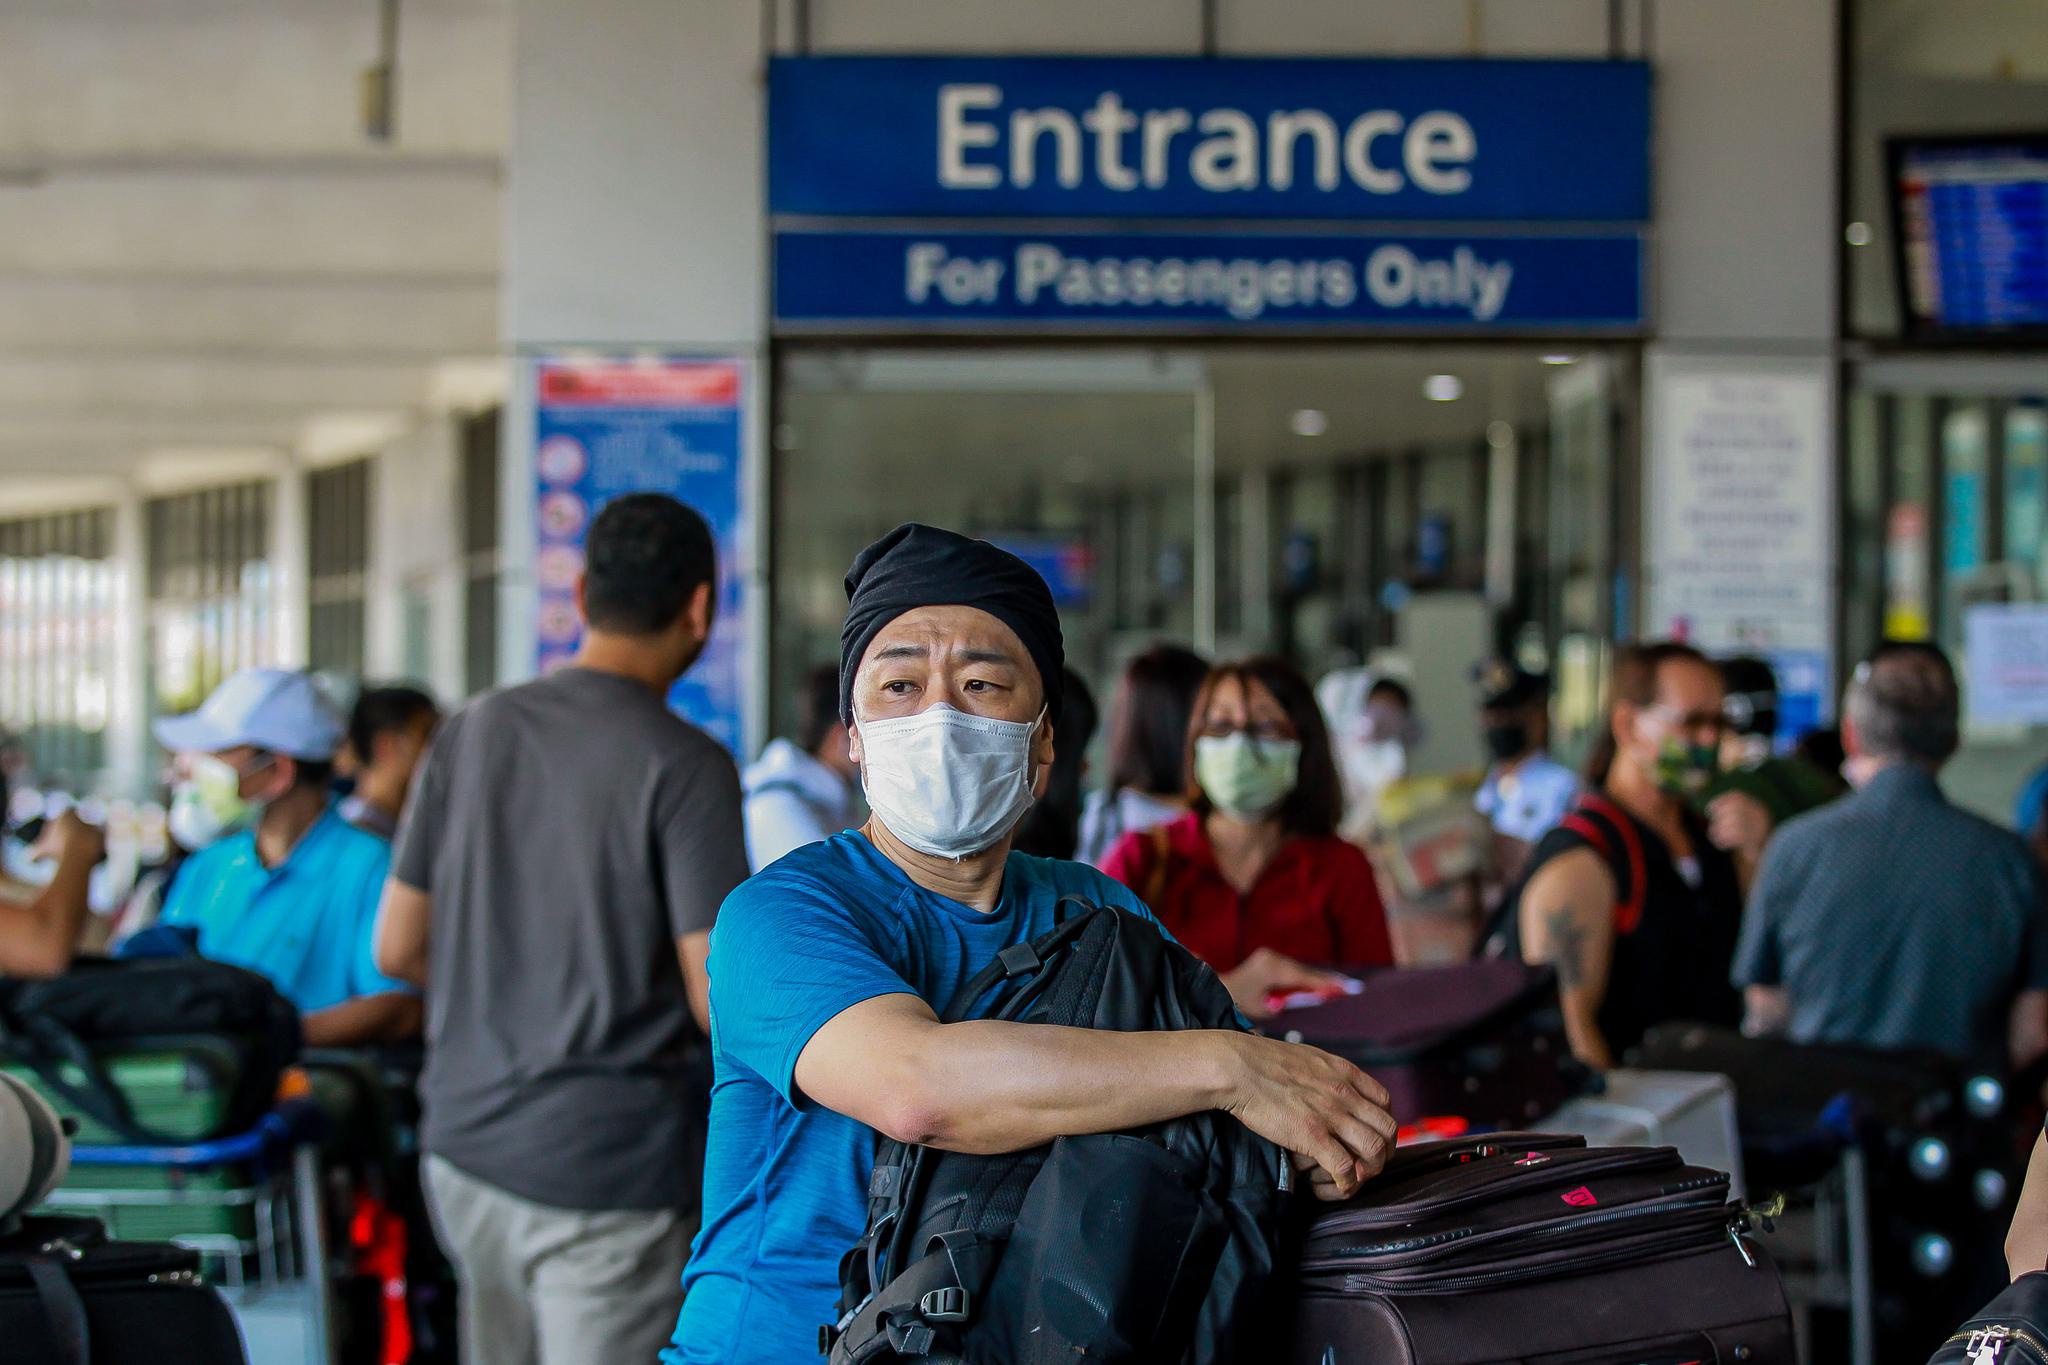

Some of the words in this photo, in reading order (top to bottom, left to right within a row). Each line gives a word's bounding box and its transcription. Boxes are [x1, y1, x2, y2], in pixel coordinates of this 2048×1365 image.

[937, 84, 1477, 193] Entrance
[906, 245, 1002, 304] For
[1016, 245, 1354, 318] Passengers
[1366, 247, 1512, 319] Only
